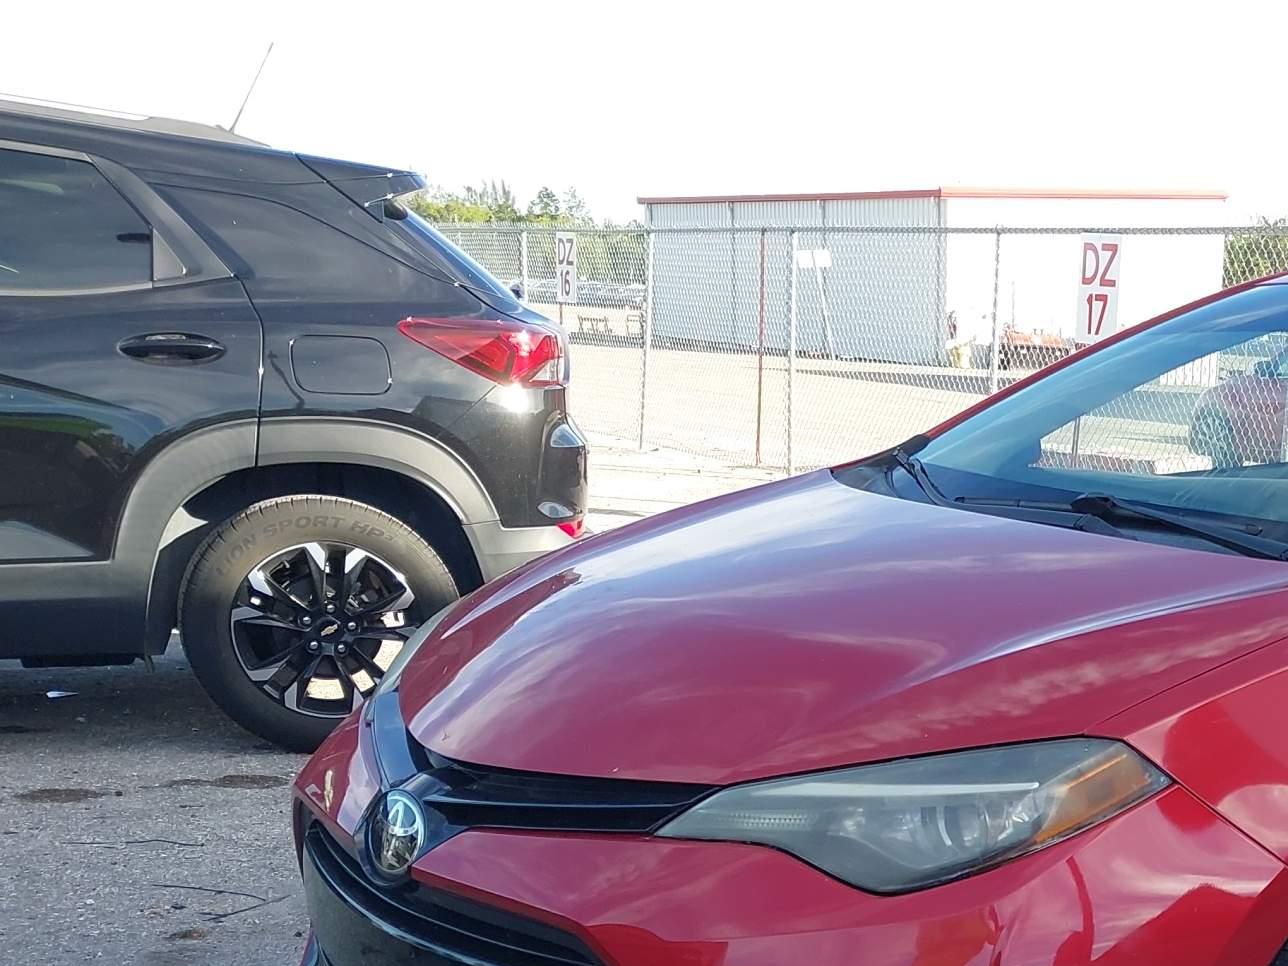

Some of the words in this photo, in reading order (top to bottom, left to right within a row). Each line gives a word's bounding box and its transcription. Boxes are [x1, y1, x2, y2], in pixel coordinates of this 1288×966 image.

[558, 238, 574, 266] DZ
[1081, 242, 1118, 287] DZ
[560, 269, 571, 297] 16
[1086, 293, 1108, 335] 17
[263, 515, 345, 538] SPORT
